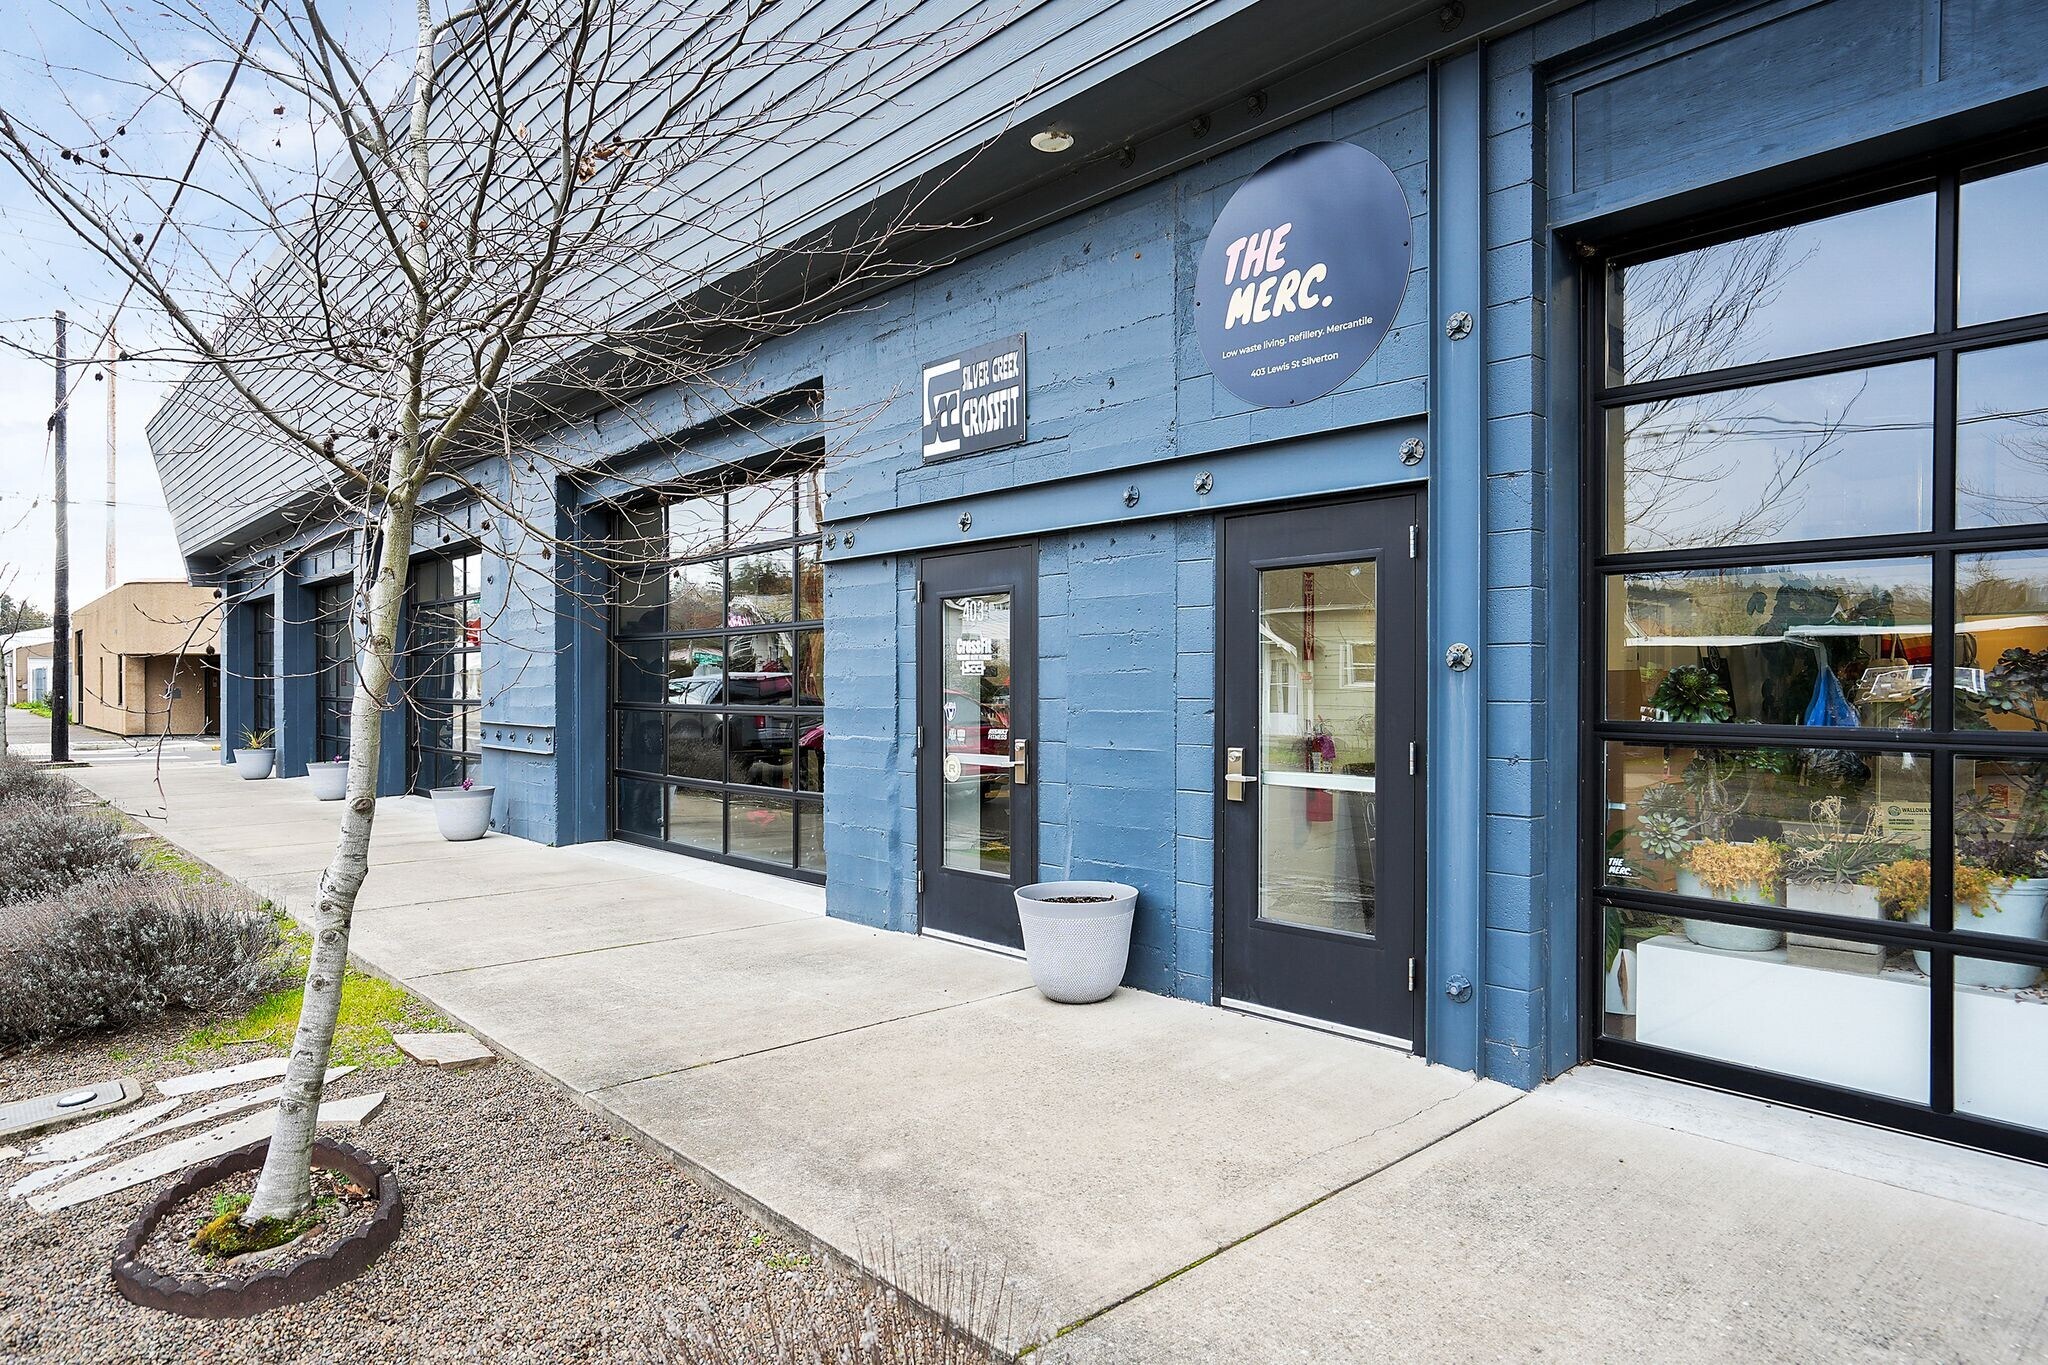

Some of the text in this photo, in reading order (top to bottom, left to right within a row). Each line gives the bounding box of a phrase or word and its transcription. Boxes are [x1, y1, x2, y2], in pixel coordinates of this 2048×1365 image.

[1224, 222, 1292, 286] THE
[1224, 263, 1333, 330] MERC.
[1222, 316, 1373, 359] Low waste living. Refillery. Mercantile
[961, 350, 1019, 392] SILVER CREEK
[1250, 352, 1339, 378] 403 Lewis St Silverton
[961, 385, 1019, 438] CROSSFIT
[962, 600, 984, 622] 403
[1608, 857, 1624, 867] THE
[1608, 865, 1632, 876] MERC.
